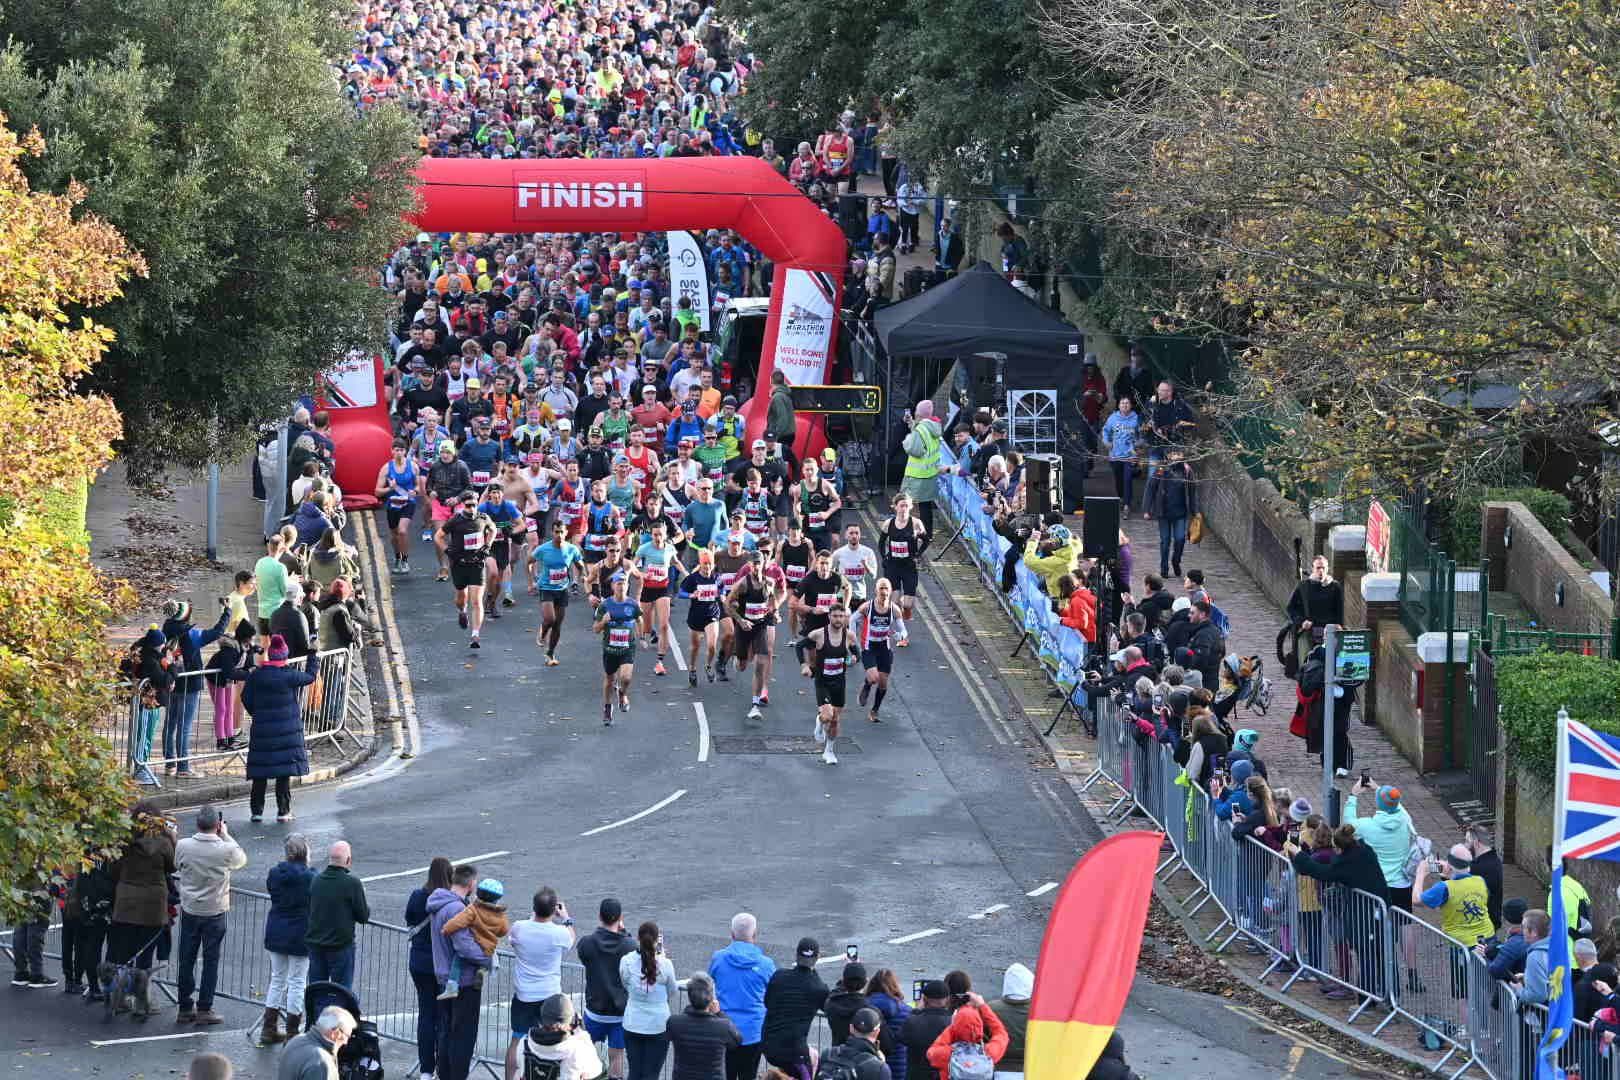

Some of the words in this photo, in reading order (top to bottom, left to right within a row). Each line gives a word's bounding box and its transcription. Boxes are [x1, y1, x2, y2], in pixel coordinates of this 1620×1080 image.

[518, 182, 643, 208] FINISH
[780, 345, 800, 355] WELL
[782, 356, 797, 365] YOU
[798, 358, 811, 369] DID
